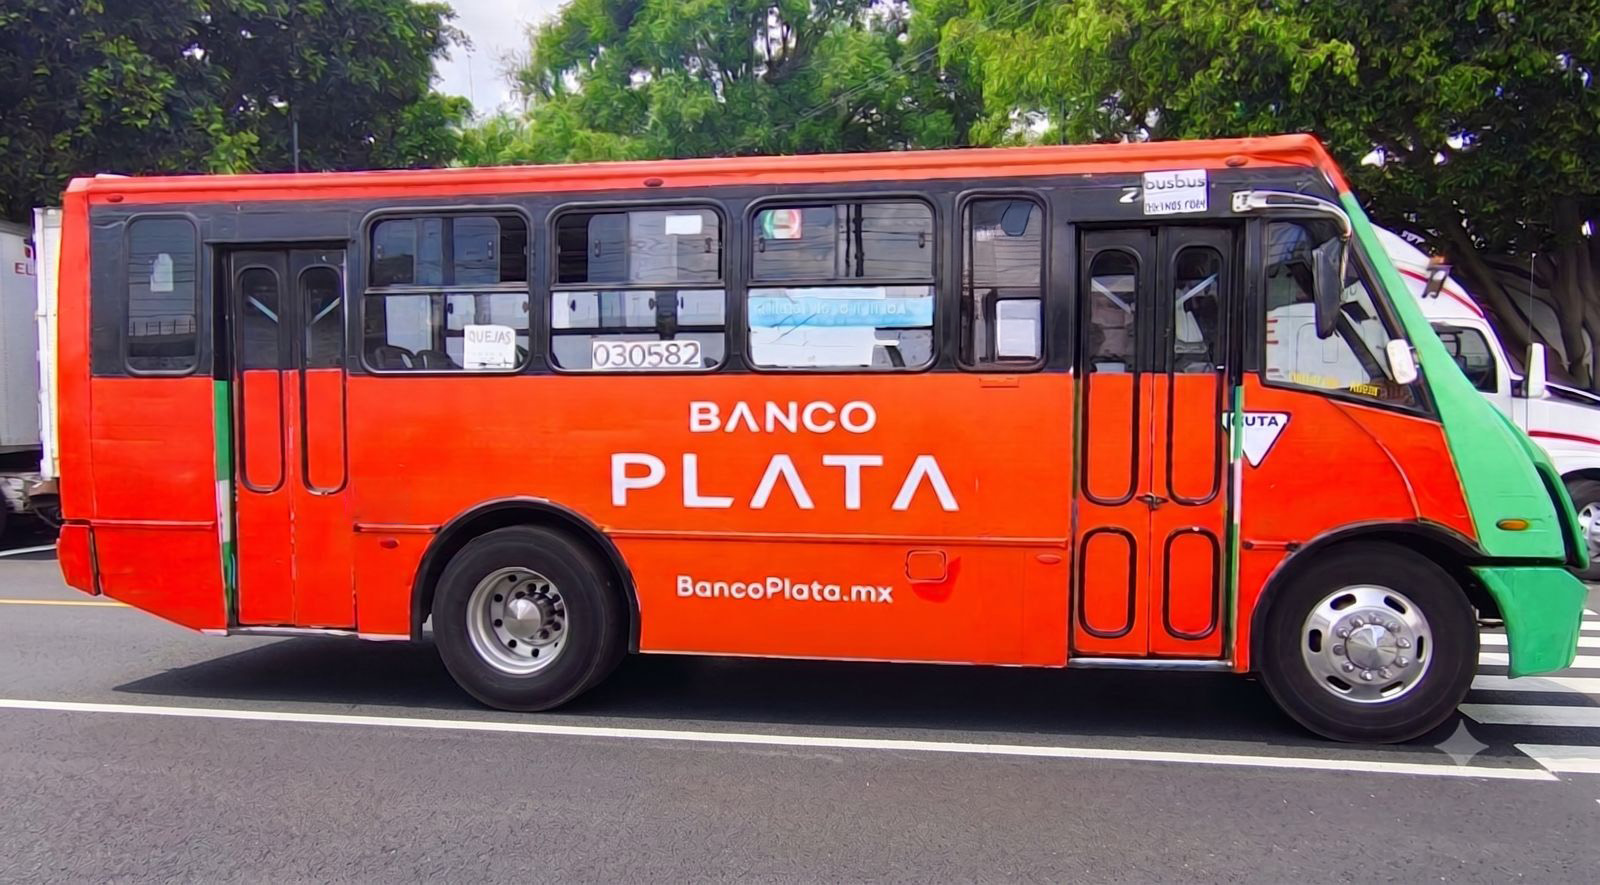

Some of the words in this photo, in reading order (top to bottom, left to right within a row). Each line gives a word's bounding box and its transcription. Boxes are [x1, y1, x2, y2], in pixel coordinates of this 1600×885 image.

[468, 329, 512, 345] QUEJAS
[593, 343, 701, 367] 030582
[689, 400, 877, 433] BANCO
[610, 453, 960, 512] PLATA
[676, 574, 894, 604] BancoPlata.mx
